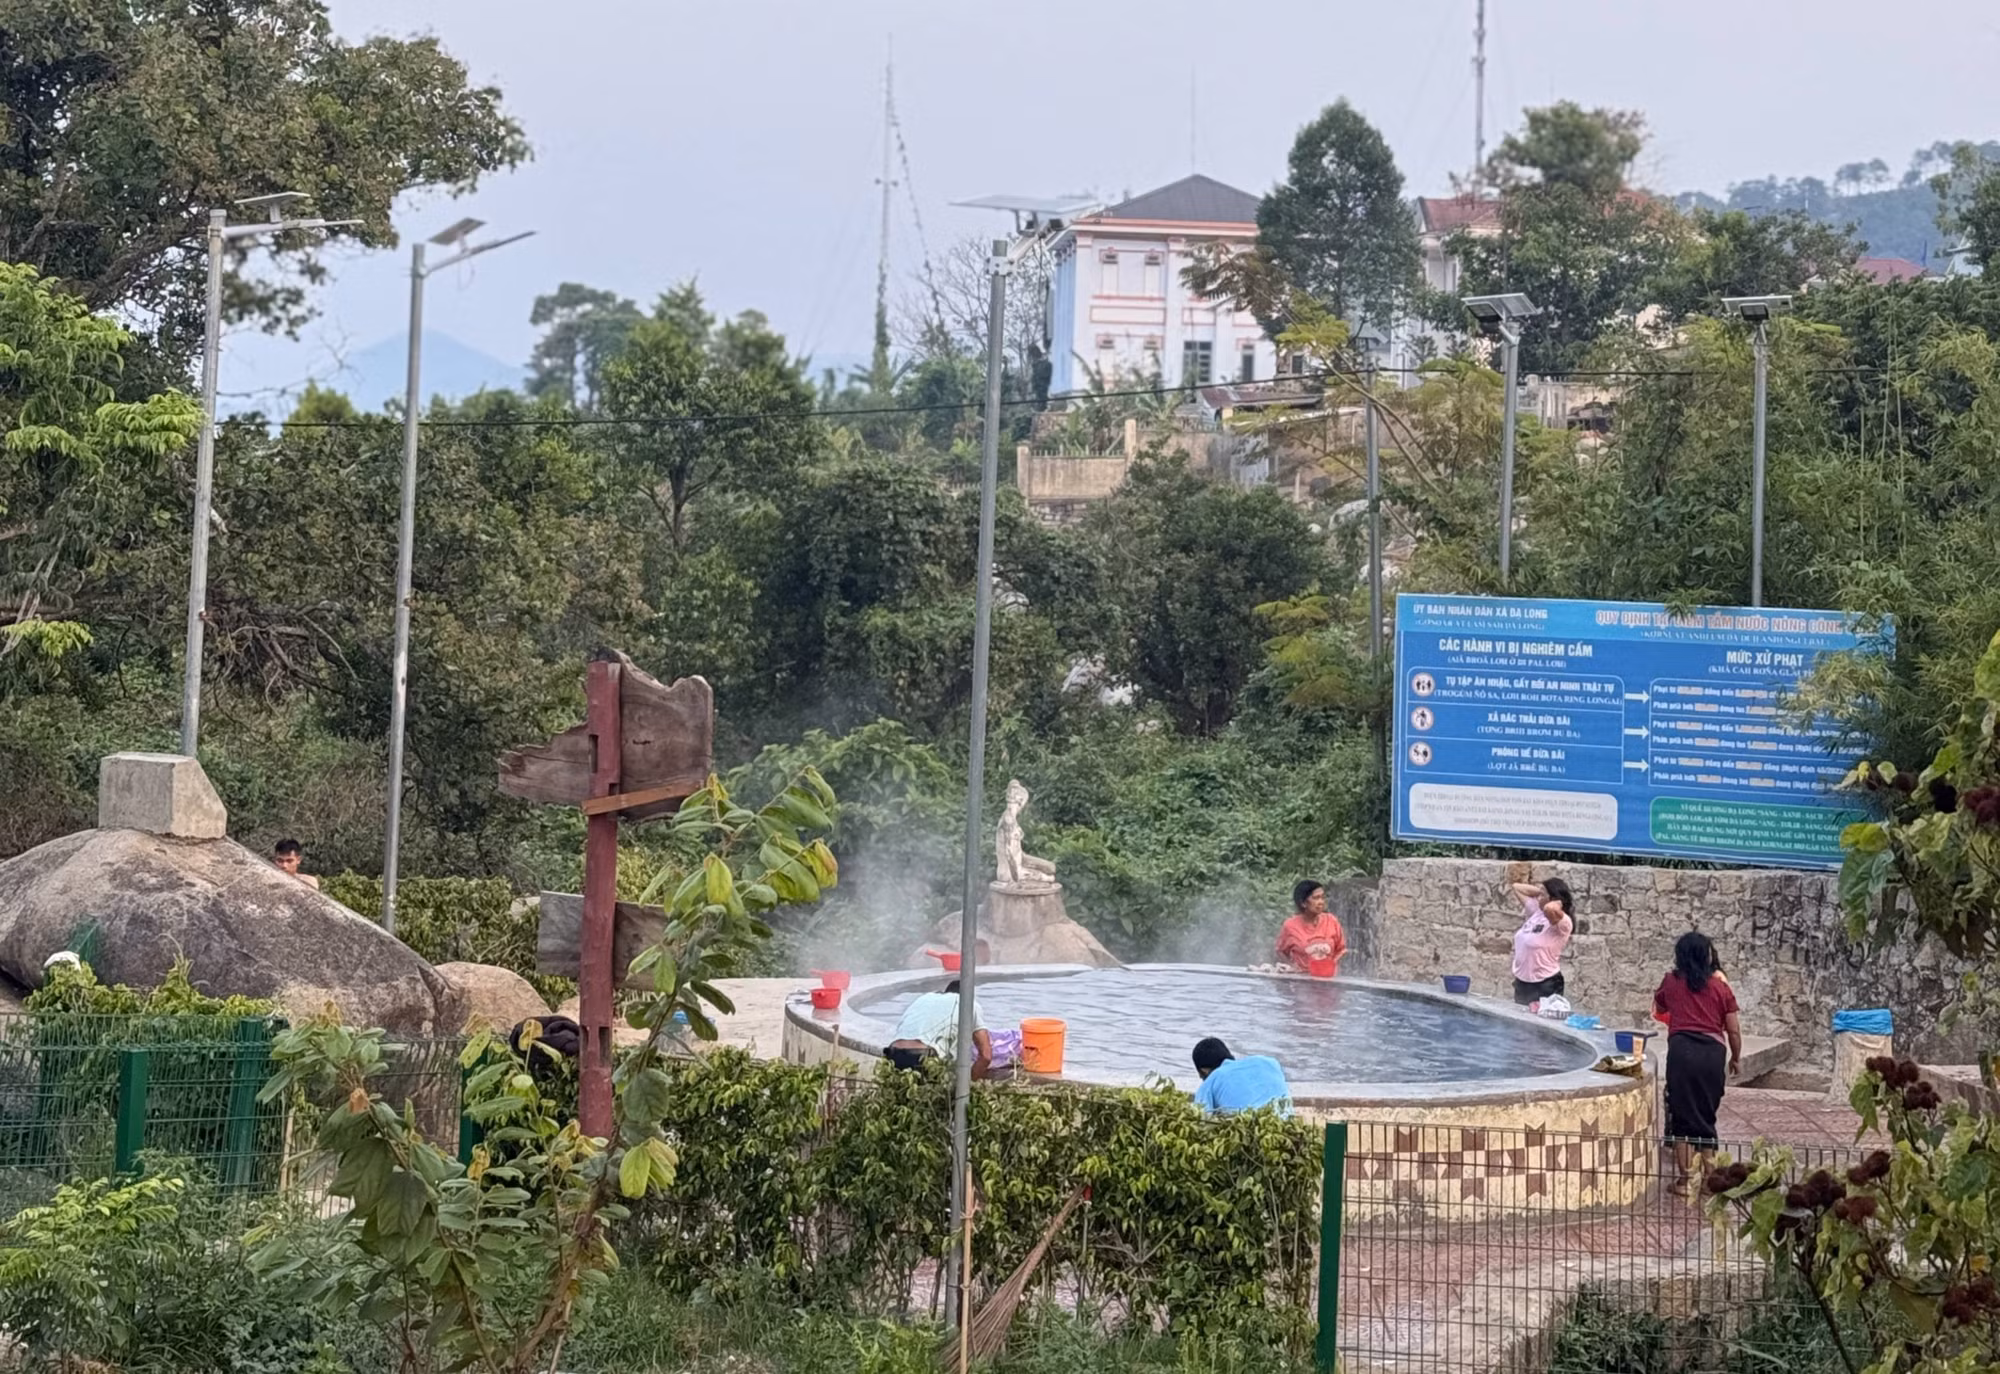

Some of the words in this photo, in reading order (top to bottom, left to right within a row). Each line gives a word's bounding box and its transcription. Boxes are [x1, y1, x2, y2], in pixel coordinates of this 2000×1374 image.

[1427, 604, 1445, 614] BAN
[1524, 609, 1548, 619] LONG
[1596, 610, 1619, 625] QUY
[1621, 612, 1650, 628] ĐỊNH
[1735, 615, 1769, 632] NƯỚC
[1439, 636, 1460, 651] CÁC
[1463, 637, 1492, 652] HÀNH
[1496, 641, 1505, 653] VI
[1509, 642, 1518, 656] BỊ
[1522, 641, 1564, 656] NGHIÊM
[1568, 641, 1592, 657] CẤM
[1727, 649, 1752, 664] MỨC
[1774, 654, 1804, 668] PHẠT
